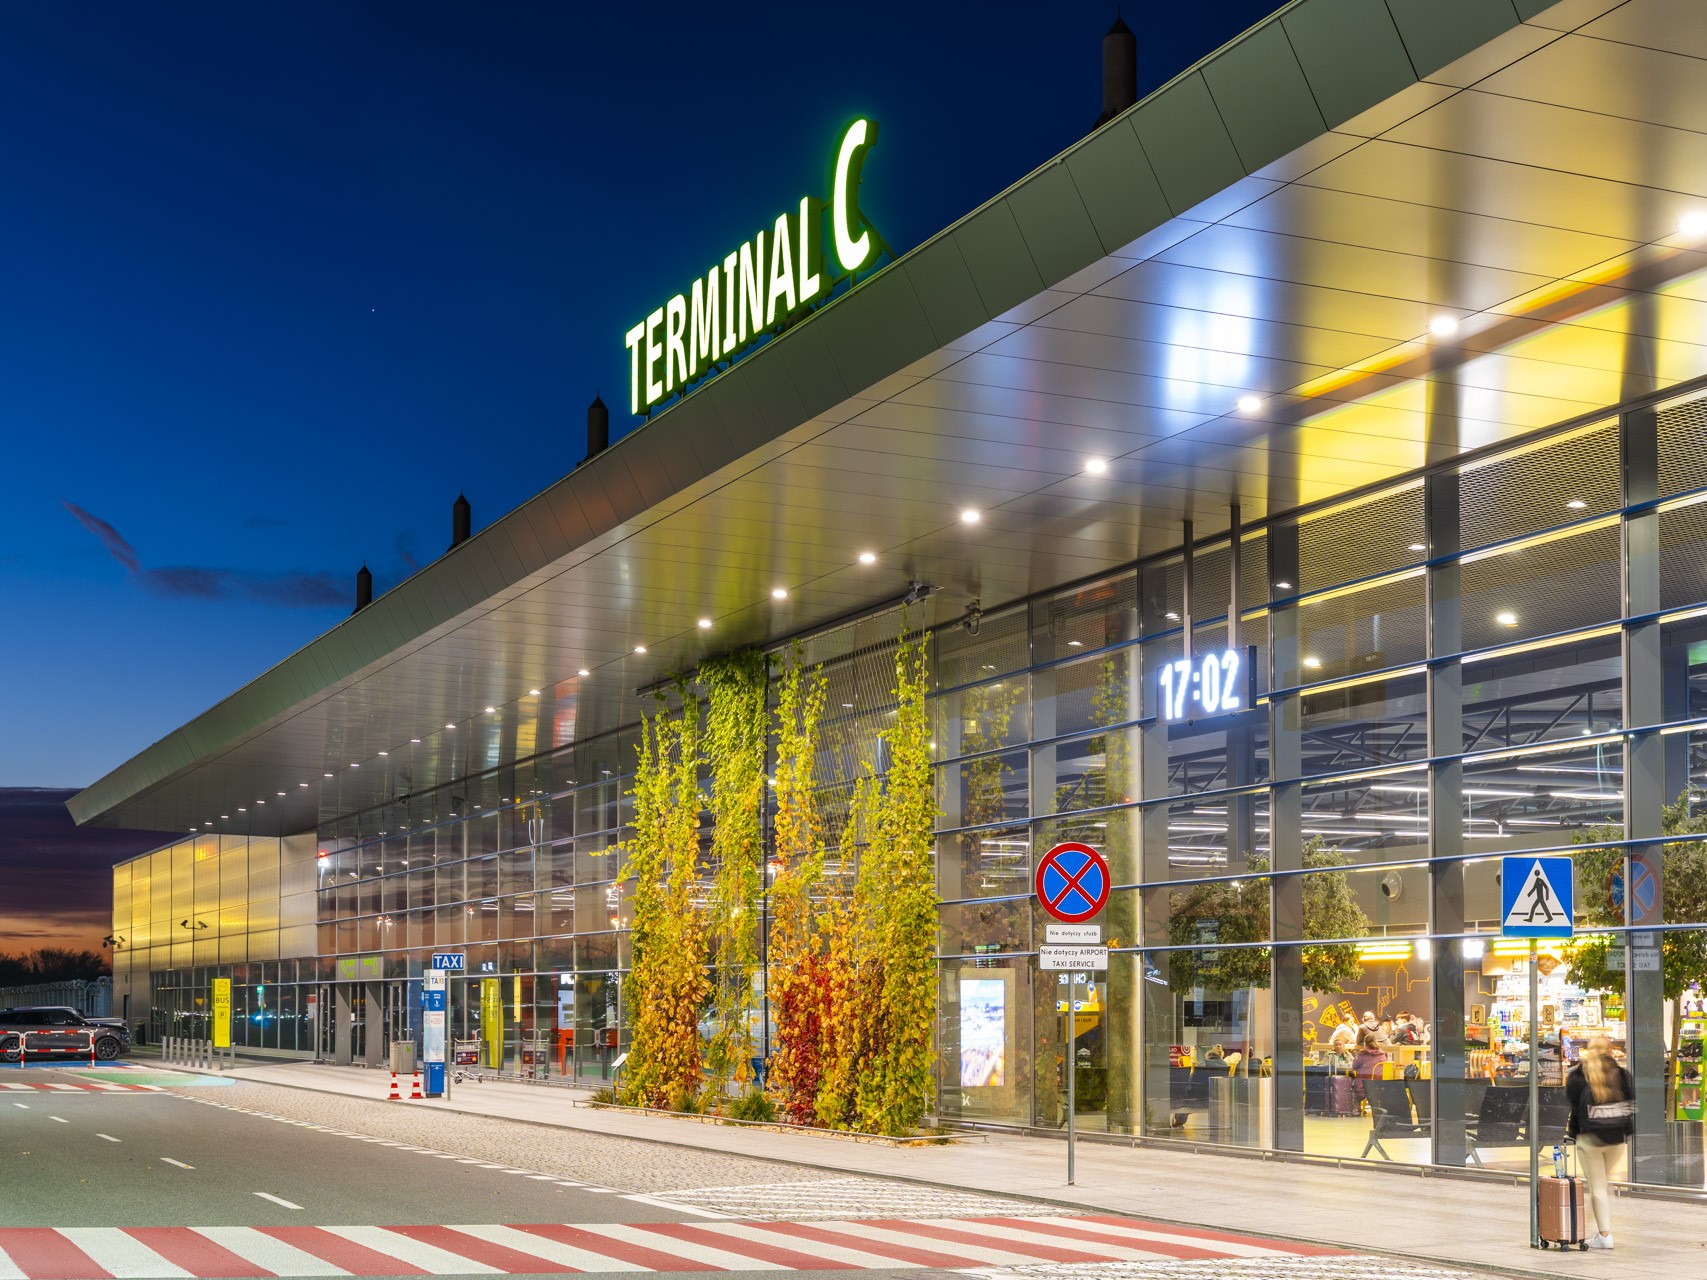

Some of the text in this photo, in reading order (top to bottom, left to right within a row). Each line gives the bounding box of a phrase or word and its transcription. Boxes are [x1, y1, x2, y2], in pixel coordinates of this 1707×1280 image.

[624, 118, 871, 415] TERMINAL C
[1160, 649, 1240, 720] 17:02
[1061, 930, 1081, 938] dotyczy
[1053, 949, 1078, 957] dotyczy
[433, 955, 463, 968] TAXI
[1068, 960, 1095, 968] SERVICE
